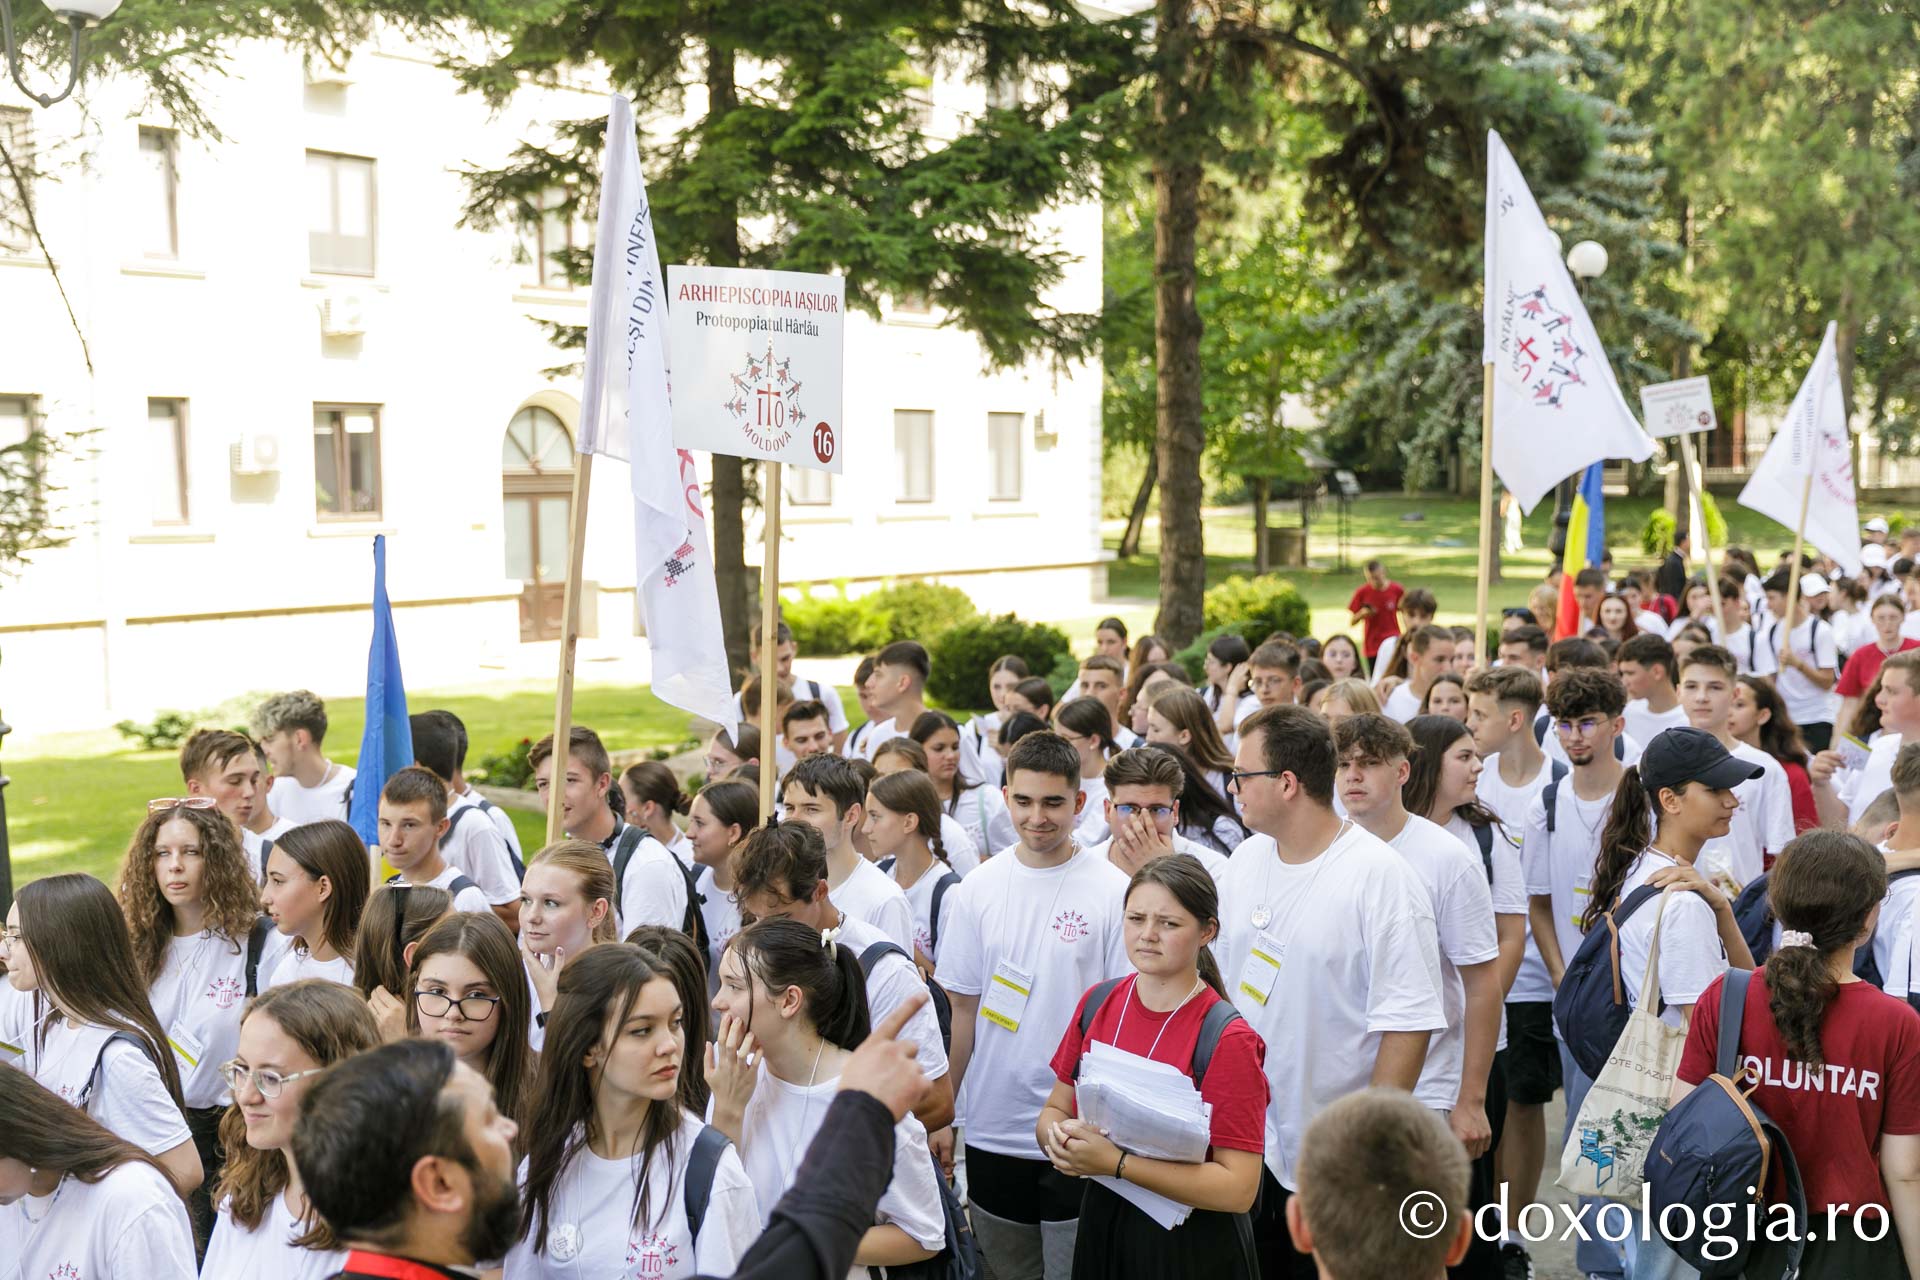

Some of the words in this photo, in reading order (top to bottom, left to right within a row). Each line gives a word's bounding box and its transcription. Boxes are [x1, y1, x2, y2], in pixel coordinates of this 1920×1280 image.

[678, 283, 792, 308] ARHIEPISCOPIA
[795, 291, 838, 315] IAȘILOR
[696, 311, 783, 333] Protopopiatul
[785, 317, 819, 337] Hârlău
[742, 422, 792, 452] MOLDOVA
[815, 429, 833, 457] 16
[1608, 1056, 1632, 1069] ÔTE
